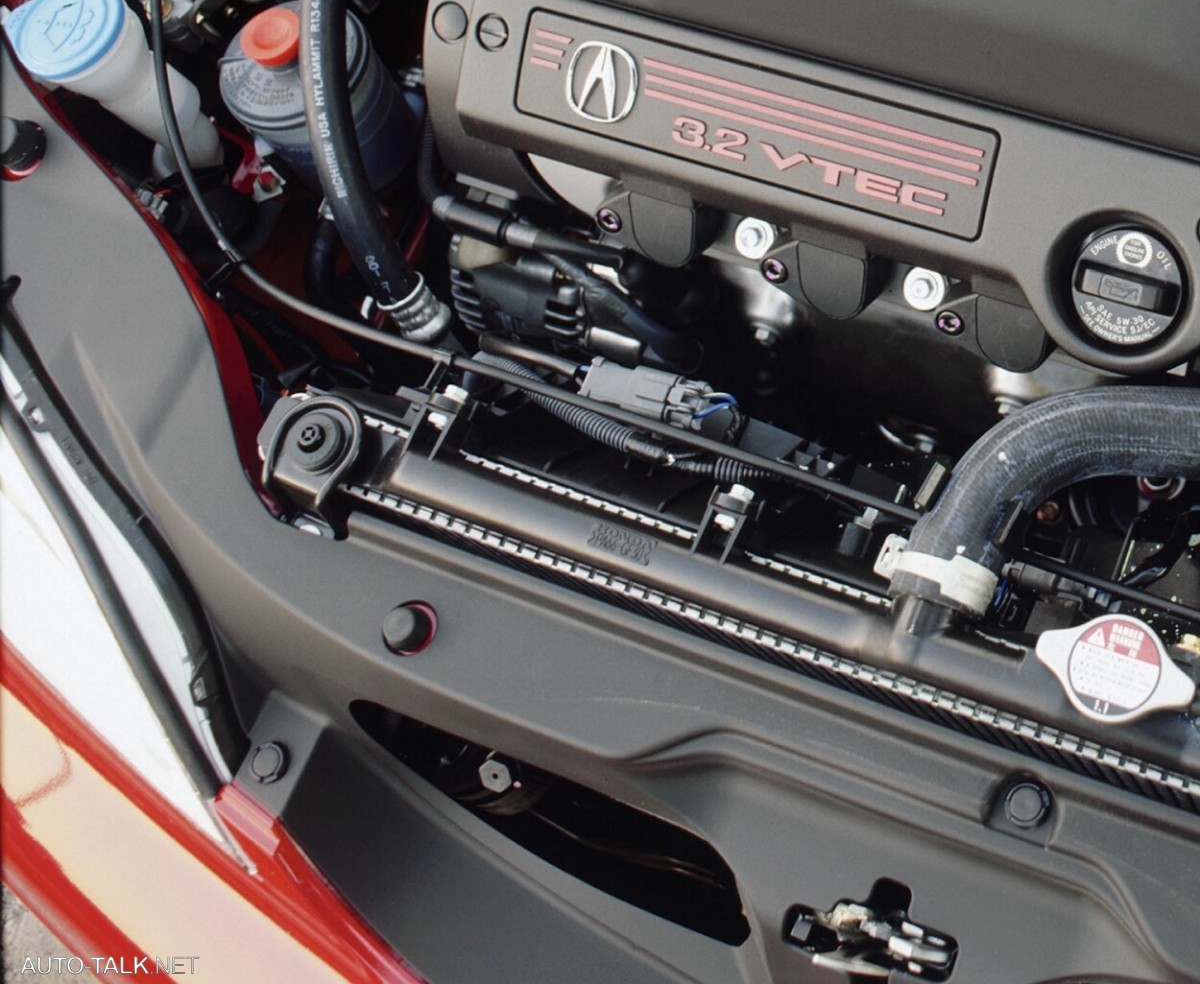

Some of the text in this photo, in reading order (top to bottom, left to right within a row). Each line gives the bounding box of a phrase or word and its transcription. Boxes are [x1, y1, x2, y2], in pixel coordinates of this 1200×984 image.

[317, 112, 331, 139] USA
[671, 115, 948, 217] 3.2 VTEC
[1090, 235, 1119, 256] ENGINE
[1156, 249, 1174, 271] OIL
[1084, 301, 1098, 318] API
[1094, 314, 1128, 334] SERVICE
[1096, 304, 1114, 321] SAE
[1112, 623, 1145, 641] DANGER
[1093, 699, 1110, 715] 1.1
